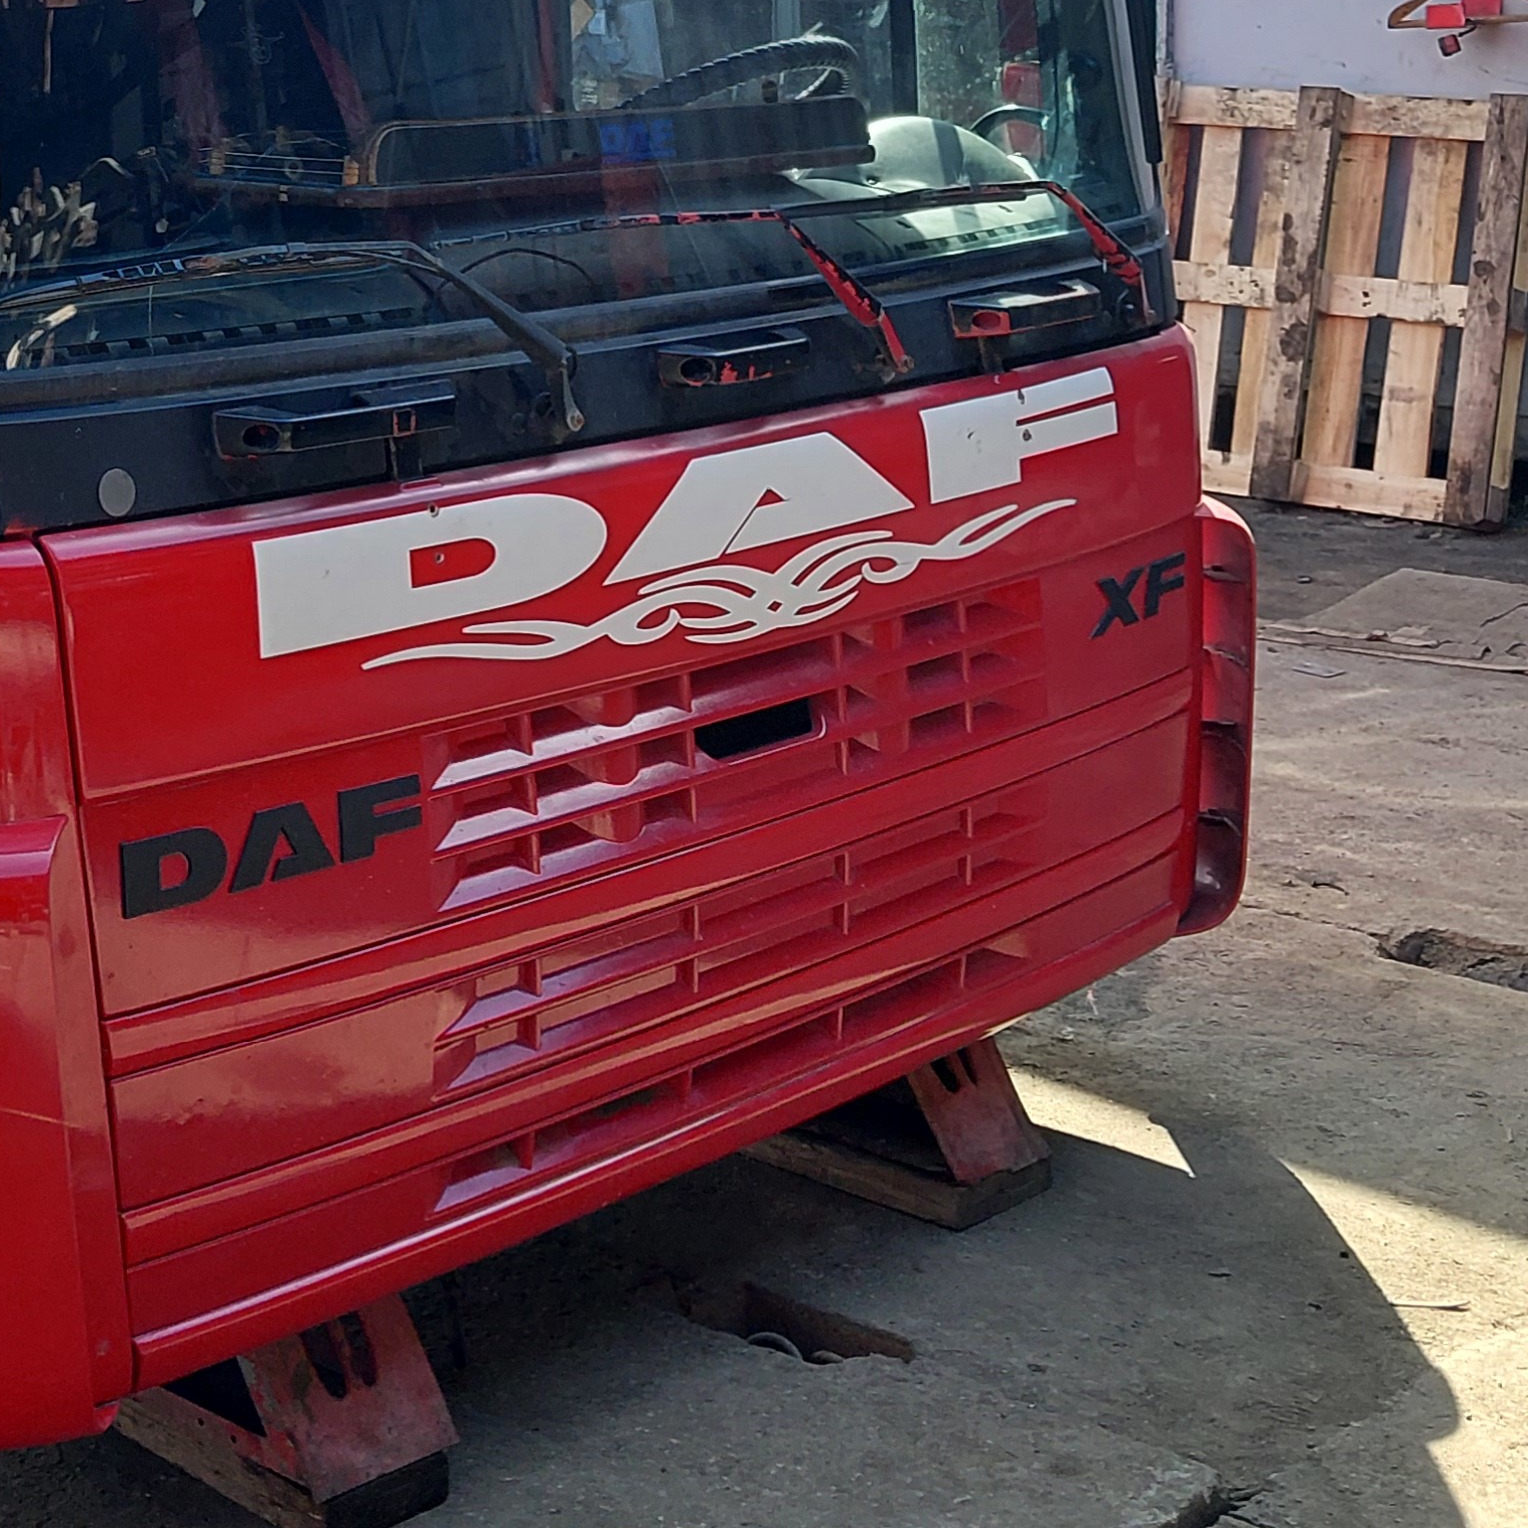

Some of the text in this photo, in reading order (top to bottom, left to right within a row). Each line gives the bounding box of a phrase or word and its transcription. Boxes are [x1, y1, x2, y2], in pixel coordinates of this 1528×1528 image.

[252, 366, 1118, 659] DAF
[1089, 551, 1186, 640] XF
[119, 773, 422, 920] DAF
